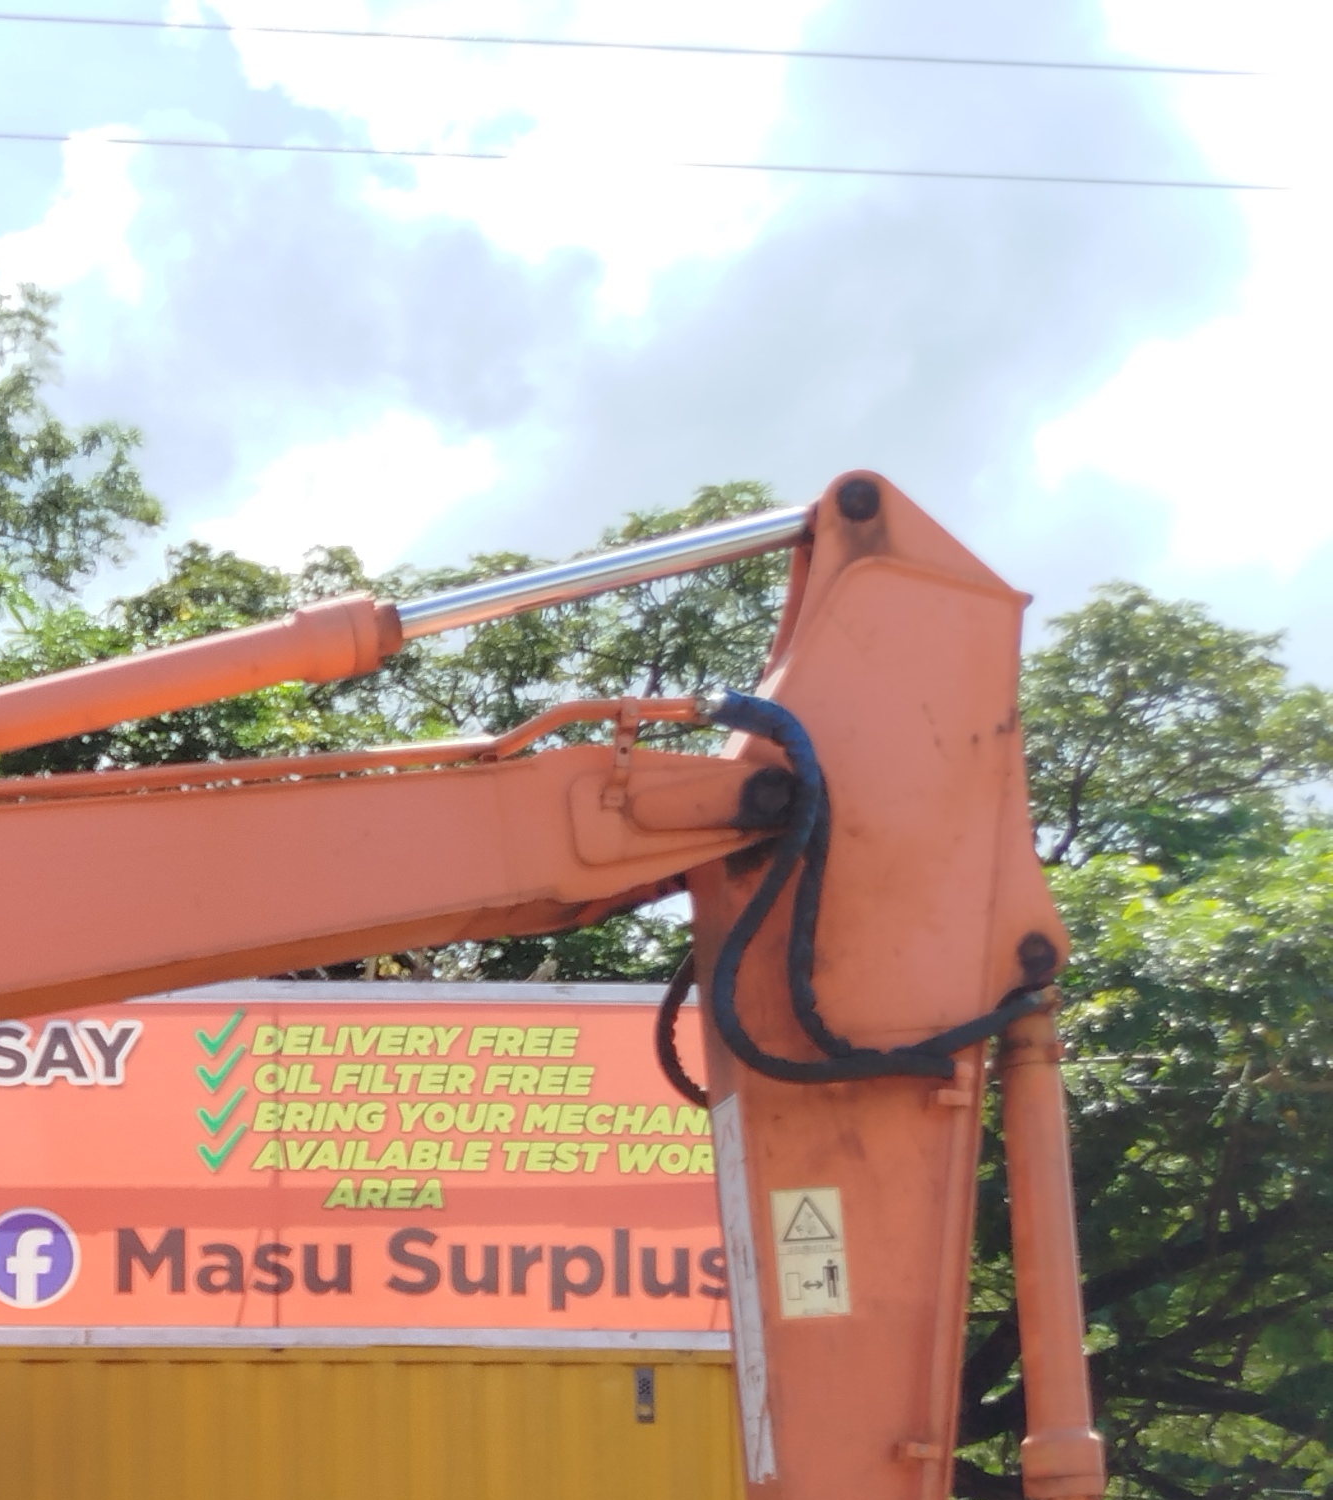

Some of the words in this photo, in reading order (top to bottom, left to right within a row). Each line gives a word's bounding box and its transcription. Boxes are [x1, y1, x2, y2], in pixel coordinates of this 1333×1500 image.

[251, 1025, 455, 1057] DELIVERY
[468, 1027, 579, 1058] FREE
[254, 1064, 322, 1095] OIL
[332, 1065, 476, 1096] FILTER
[483, 1066, 595, 1096] FREE
[253, 1102, 385, 1133] BRING
[400, 1102, 515, 1134] YOUR
[522, 1104, 712, 1137] MECHAN
[250, 1140, 492, 1172] AVAILABLE
[502, 1142, 608, 1172] TEST
[618, 1143, 715, 1175] WOR
[324, 1178, 445, 1210] AREA
[116, 1227, 351, 1296] Masu
[386, 1228, 730, 1310] Surplus
